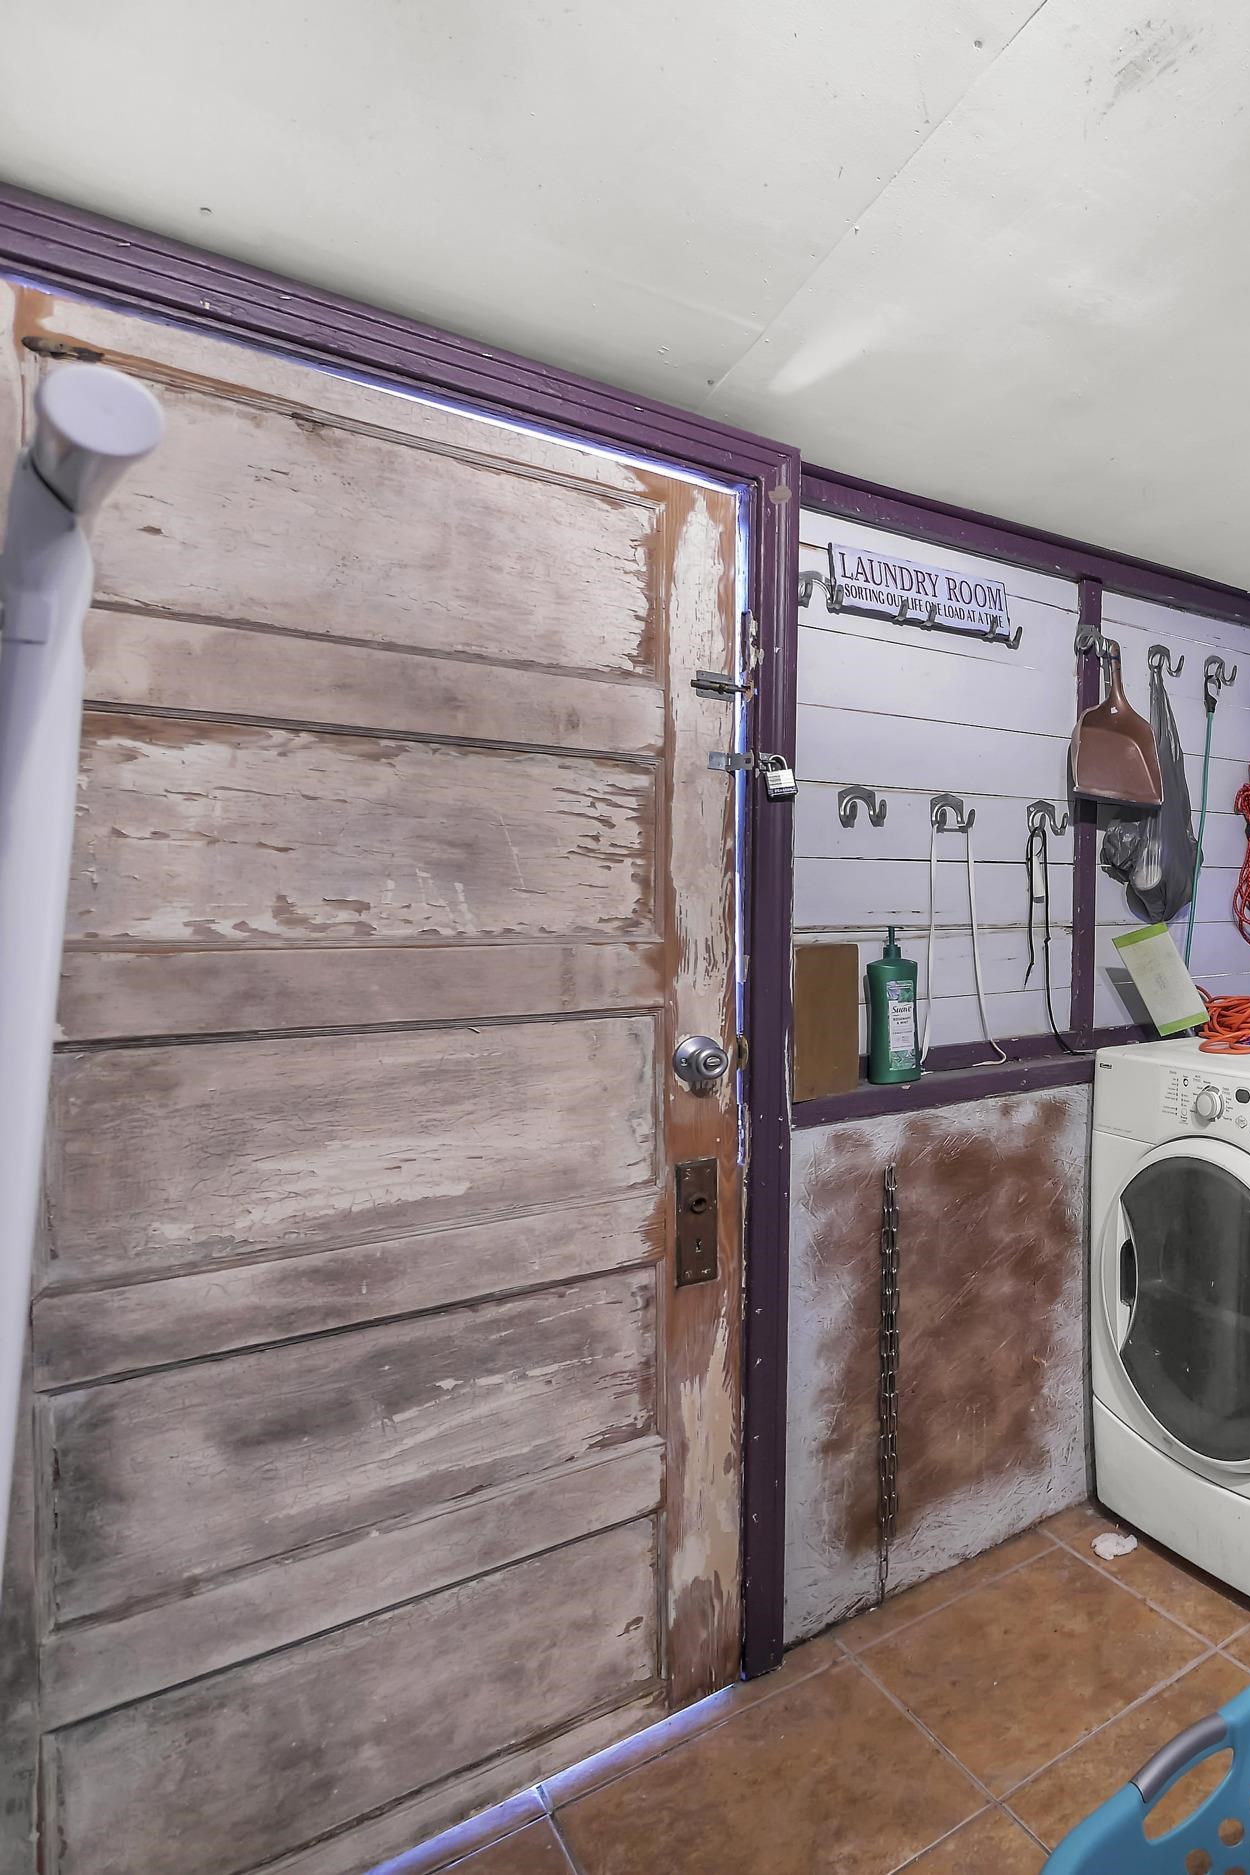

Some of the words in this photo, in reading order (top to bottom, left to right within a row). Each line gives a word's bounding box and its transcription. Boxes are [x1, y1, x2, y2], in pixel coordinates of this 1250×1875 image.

[839, 552, 940, 598] LAUNDRY
[945, 576, 1003, 612] ROOM
[844, 583, 885, 605] SORTING
[907, 596, 924, 613] LIFE
[943, 604, 966, 621] LOAD
[966, 609, 976, 622] AT
[977, 612, 985, 625] A
